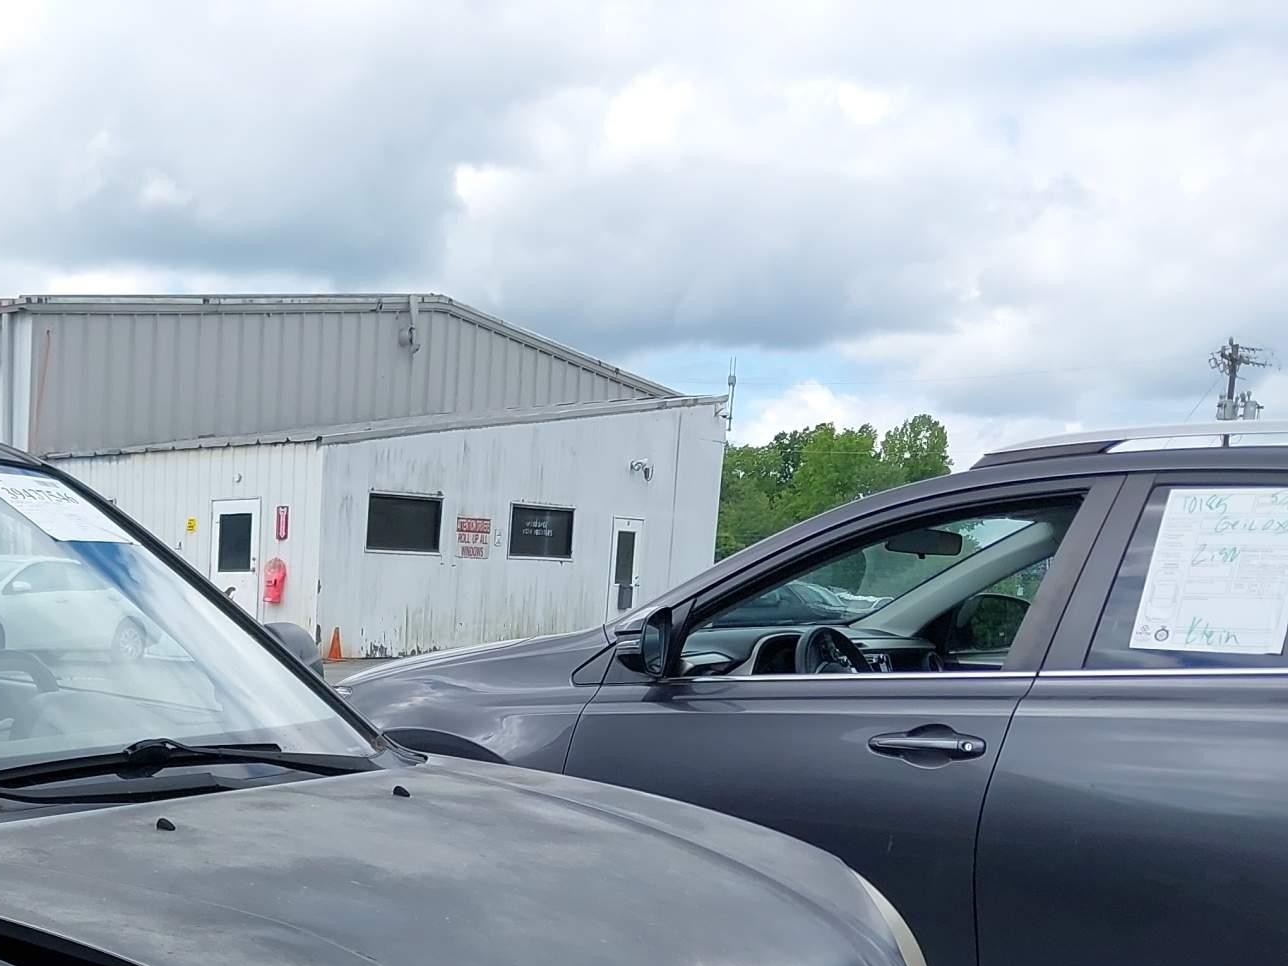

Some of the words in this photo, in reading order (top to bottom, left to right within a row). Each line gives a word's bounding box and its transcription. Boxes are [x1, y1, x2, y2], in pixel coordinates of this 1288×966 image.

[2, 486, 80, 505] 39437546
[458, 533, 471, 544] ROLL
[479, 534, 489, 545] ALL
[461, 546, 484, 557] WINDOWS
